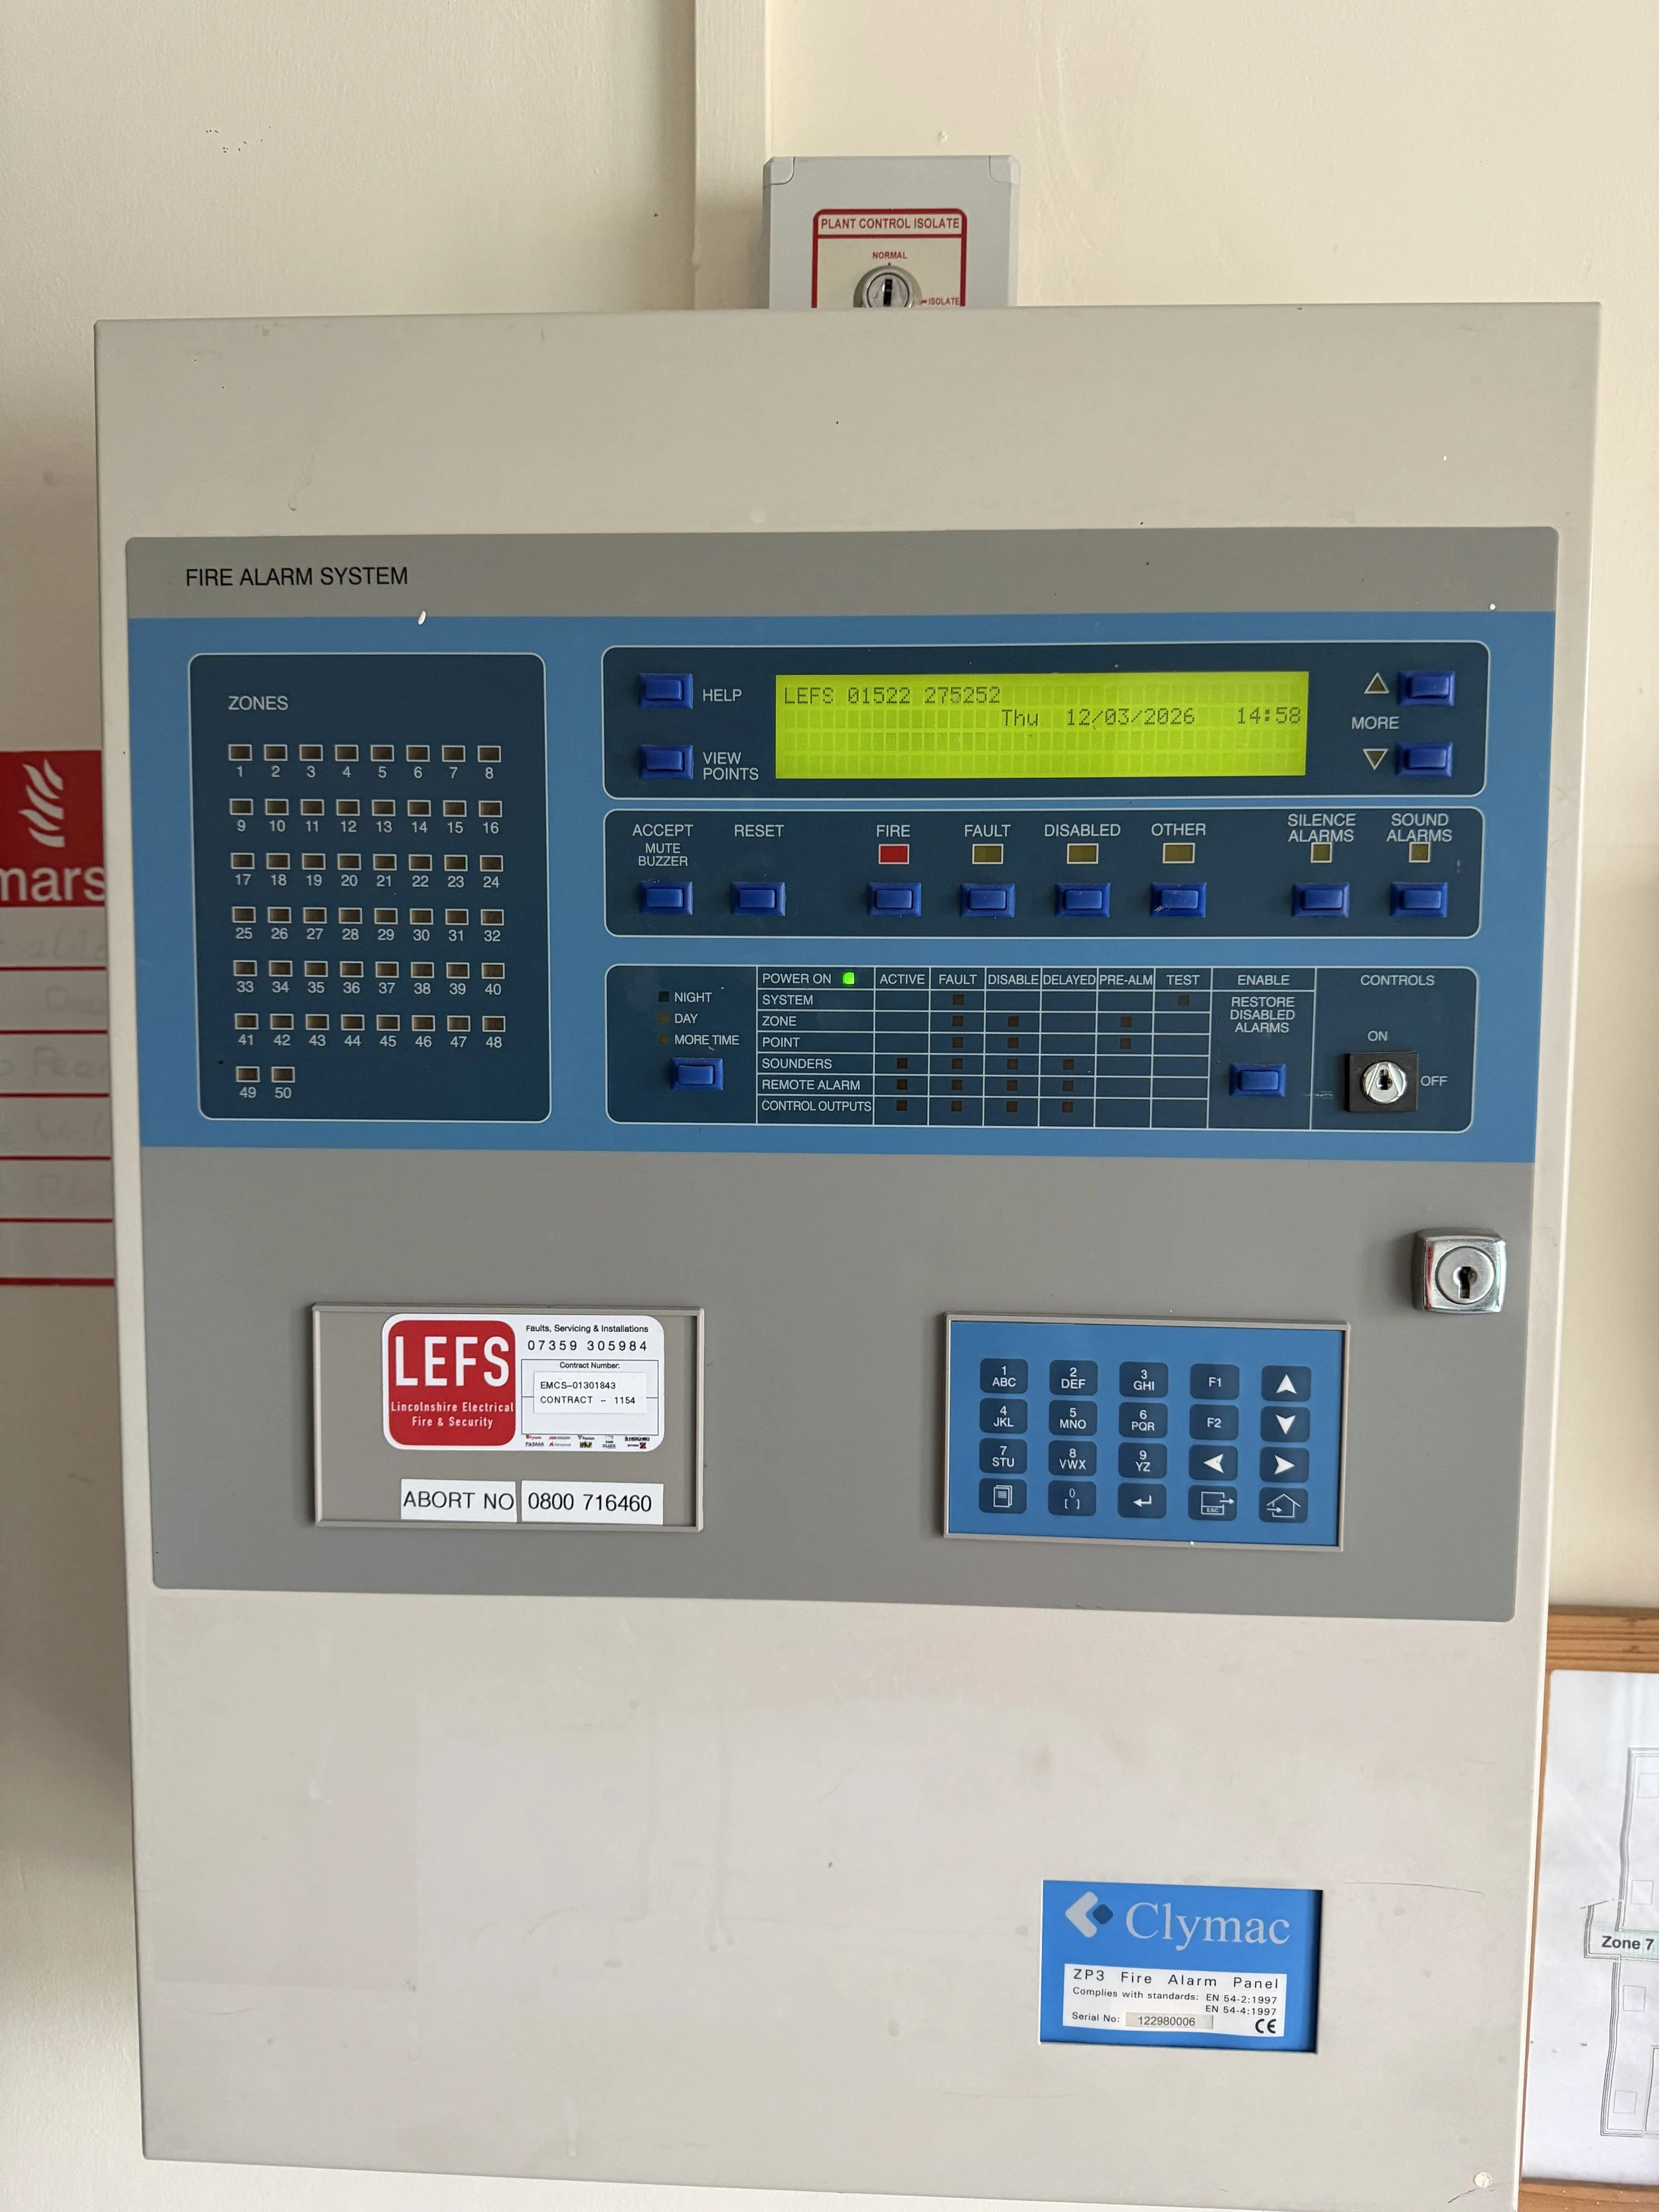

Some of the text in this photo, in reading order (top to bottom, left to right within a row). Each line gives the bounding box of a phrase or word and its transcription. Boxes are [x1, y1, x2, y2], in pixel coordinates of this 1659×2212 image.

[821, 218, 960, 229] PLANT CONTROL ISOLATE
[872, 251, 907, 259] NORMAL
[928, 297, 959, 306] ISOLATE
[186, 566, 407, 587] FIRE ALARM SYSTEM
[703, 688, 742, 702] HELP
[784, 686, 1001, 705] LEFS 01522 275252
[228, 695, 289, 711] ZONES
[1001, 706, 1301, 727] Thu 12/03/2026 14:58
[1351, 716, 1400, 730] MORE
[702, 751, 742, 765] VIEW
[236, 765, 494, 779] 1 2 3 4 5 6 7 8
[703, 767, 759, 780] POINTS
[1287, 813, 1356, 827] SILENCE
[1391, 812, 1449, 826] SOUND
[632, 824, 694, 837] ACCEPT
[734, 824, 785, 838] RESET
[877, 824, 910, 838] FIRE
[964, 824, 1011, 838] FAULT
[1045, 824, 1121, 837] DISABLED
[1151, 823, 1206, 836] OTHER
[1287, 829, 1354, 843] ALARMS
[1386, 829, 1453, 843] ALARMS
[645, 843, 681, 853] MUTE
[638, 855, 688, 867] BUZZER
[235, 873, 500, 888] 17 18 19 20 21 22 23 24
[762, 973, 831, 984] POWER ON
[879, 974, 925, 985] ACTIVE
[939, 974, 977, 985] FAULT
[987, 974, 1039, 986] DISABLE
[1043, 974, 1097, 986] DELAYED
[1099, 974, 1153, 986] PRE-ALM
[1166, 974, 1200, 986] TEST
[1238, 974, 1290, 986] ENABLE
[1360, 974, 1435, 986] CONTROLS
[236, 980, 502, 995] 33 34 35 36 37 38 39 40
[674, 992, 713, 1003] NIGHT
[762, 994, 814, 1005] SYSTEM
[1231, 996, 1295, 1011] RESTORE
[674, 1013, 698, 1024] DAY
[762, 1015, 797, 1027] ZONE
[1229, 1009, 1295, 1021] DISABLED
[1234, 1022, 1289, 1033] ALARMS
[674, 1034, 739, 1046] MORE TIME
[1367, 1030, 1388, 1042] ON
[762, 1037, 801, 1048] POINT
[762, 1058, 832, 1069] SOUNDERS
[762, 1079, 860, 1090] REMOTE ALARM
[1420, 1075, 1448, 1086] OFF
[239, 1086, 292, 1099] 49 50
[761, 1100, 872, 1113] CONTROL OUTPUTS
[526, 1324, 552, 1333] Faults,
[554, 1324, 591, 1334] Servicing
[601, 1324, 649, 1333] Installations
[528, 1340, 647, 1351] 07359 305984
[395, 1336, 509, 1387] LEFS
[559, 1361, 620, 1370] Contract Number:
[1001, 1366, 1007, 1377] 1
[1069, 1366, 1078, 1378] 2
[1141, 1369, 1147, 1380] 3
[540, 1381, 616, 1390] EMCS-01301843
[992, 1376, 1017, 1387] ABC
[1061, 1378, 1086, 1389] DEF
[1133, 1377, 1155, 1391] GHI
[1208, 1376, 1222, 1387] F1
[540, 1396, 593, 1404] CONTRACT
[391, 1401, 514, 1412] Lincolnshire Electrical
[999, 1405, 1007, 1416] 4
[1069, 1407, 1077, 1418] 5
[1139, 1409, 1147, 1420] 6
[412, 1416, 493, 1430] Fire & Security
[993, 1417, 1014, 1428] JKL
[1060, 1418, 1086, 1430] MNO
[1131, 1418, 1155, 1432] PQR
[1207, 1417, 1222, 1428] F2
[999, 1445, 1007, 1455] 7
[1069, 1448, 1076, 1458] 8
[1139, 1449, 1147, 1460] 9
[992, 1457, 1015, 1467] STU
[1059, 1456, 1086, 1470] VWX
[1135, 1458, 1151, 1472] YZ
[1068, 1488, 1076, 1498] 0
[403, 1491, 514, 1511] ABORT NO
[528, 1492, 652, 1512] 0800 716460
[1125, 1902, 1290, 1951] Clymac
[1601, 1935, 1654, 1951] Zone 7
[1073, 1968, 1278, 1989] ZP3 Fire Alarm Panel
[1072, 1986, 1118, 1998] Complies
[1147, 1992, 1199, 2002] standards:
[1206, 1993, 1277, 2004] EN 54-2:1997
[1205, 2004, 1277, 2016] EN 54-4:1997
[1072, 2012, 1120, 2024] Serial No:
[1138, 2016, 1196, 2027] 122980006
